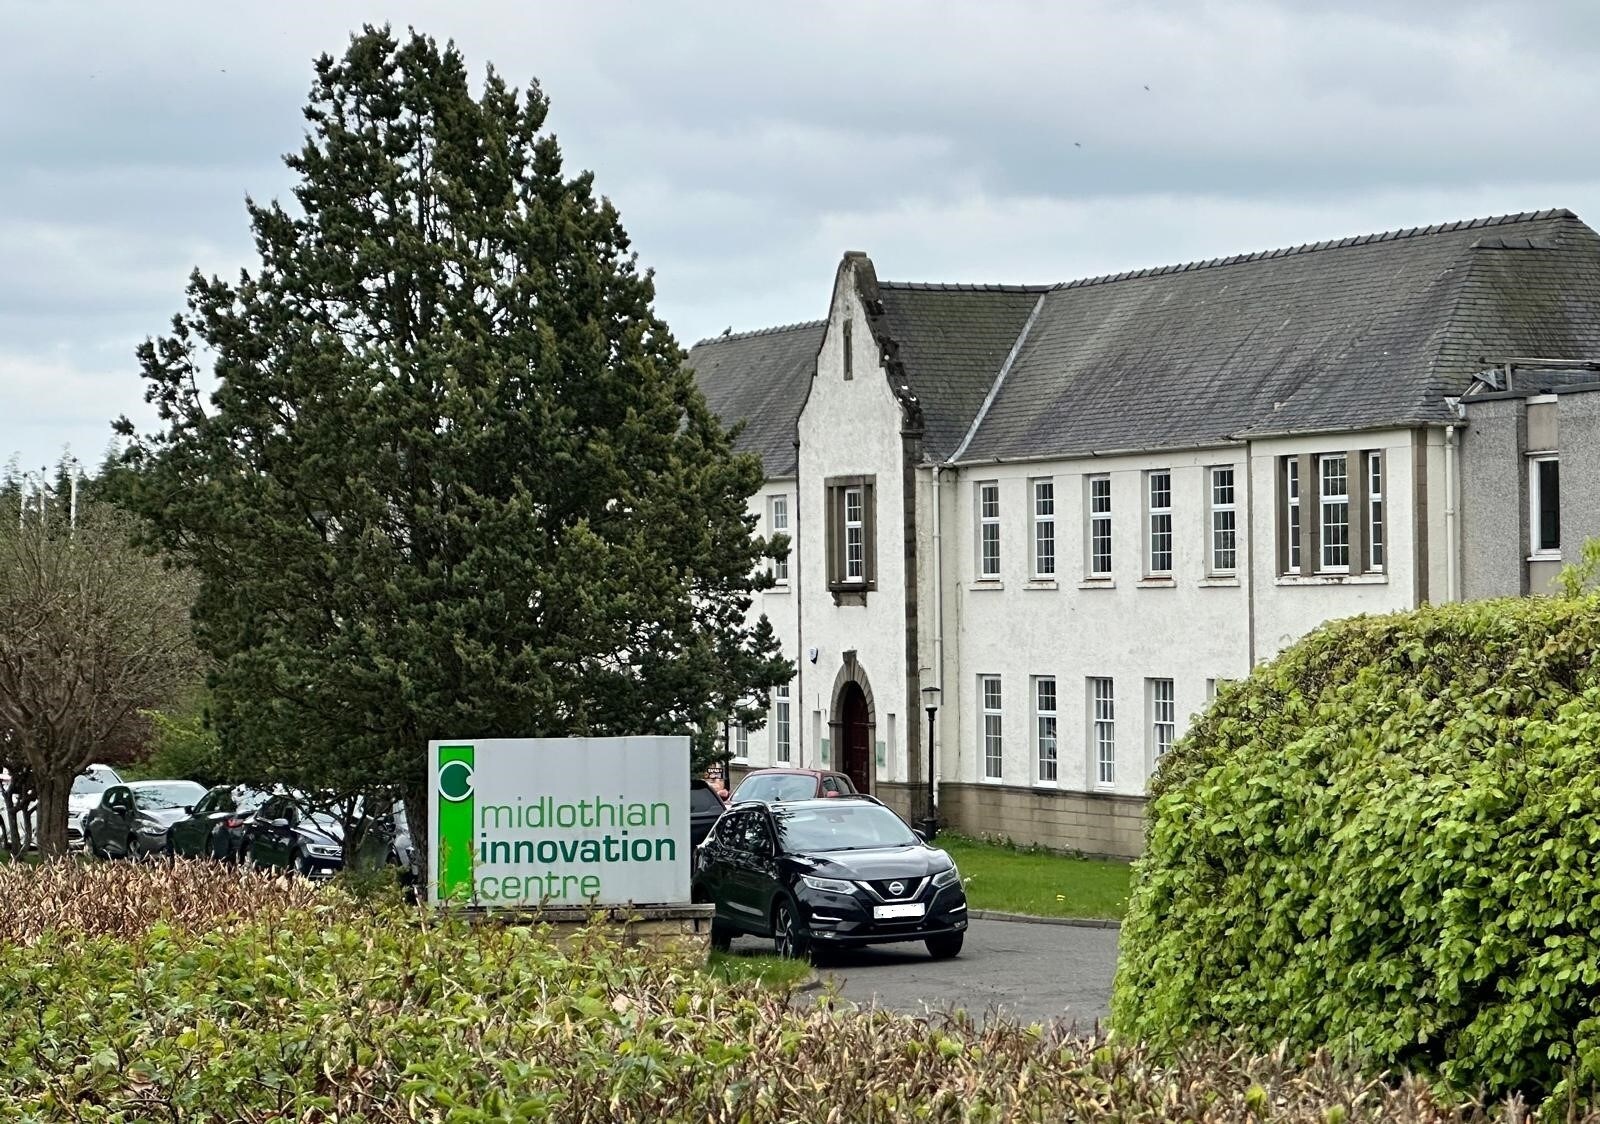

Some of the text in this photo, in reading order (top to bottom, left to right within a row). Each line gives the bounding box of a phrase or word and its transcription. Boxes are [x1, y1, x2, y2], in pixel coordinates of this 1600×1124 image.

[481, 795, 670, 828] midlothian
[480, 831, 676, 864] innovation
[480, 871, 601, 900] centre
